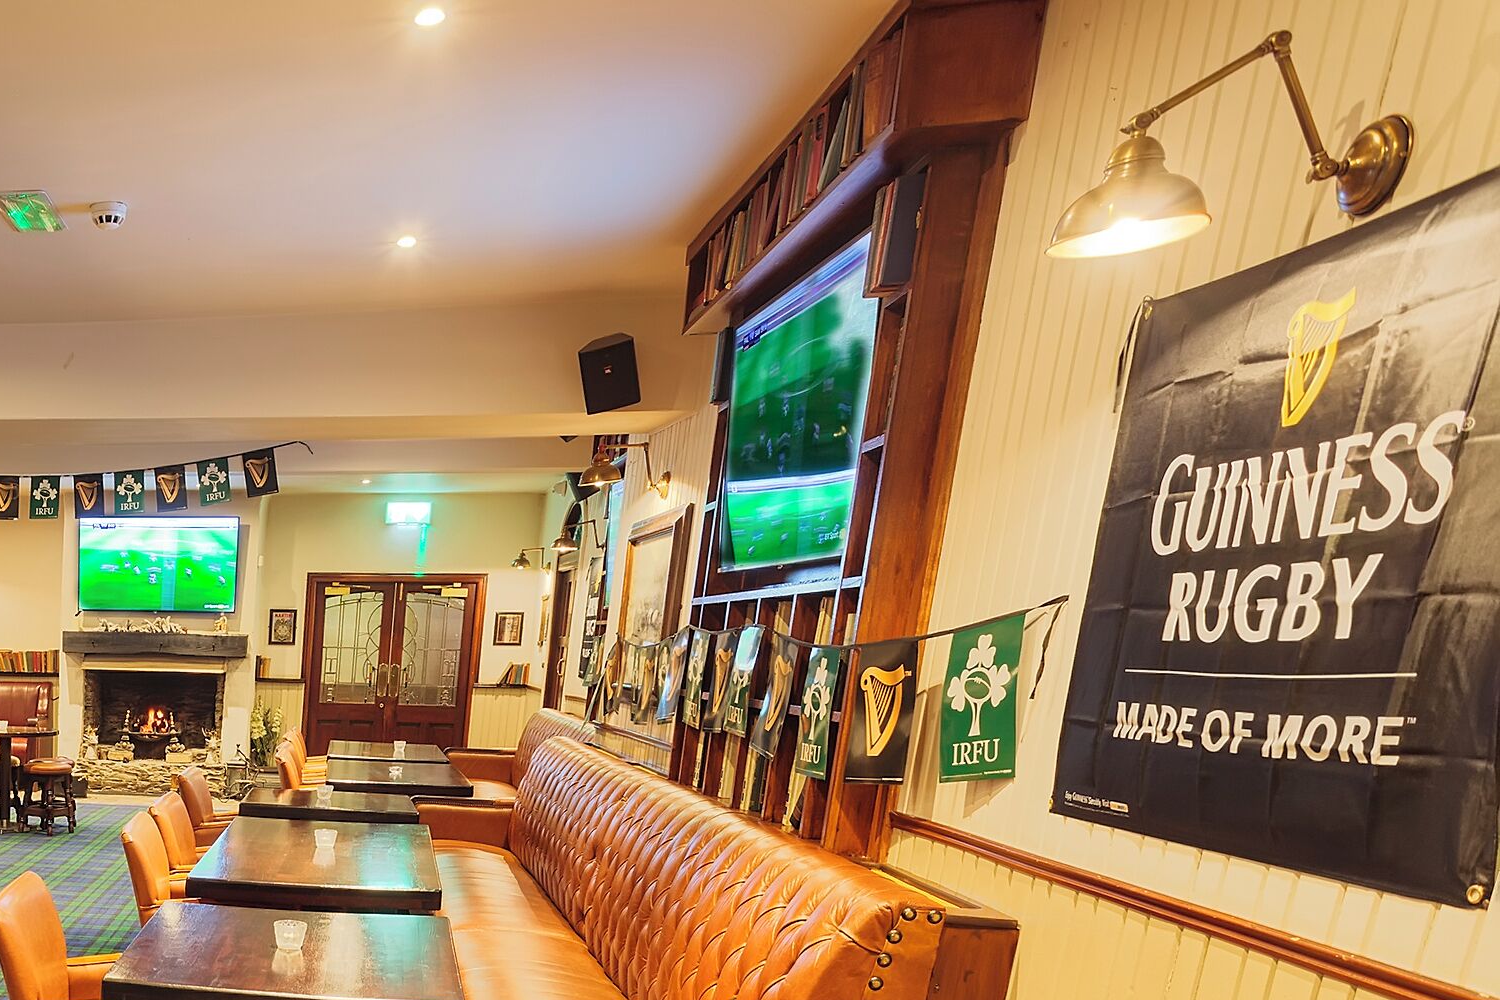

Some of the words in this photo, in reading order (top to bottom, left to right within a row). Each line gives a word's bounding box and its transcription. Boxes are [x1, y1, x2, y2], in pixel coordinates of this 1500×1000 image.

[120, 502, 140, 511] IRFU
[205, 491, 226, 502] IRFU
[35, 507, 54, 516] IRFU
[1162, 552, 1384, 643] RUGBY
[727, 704, 744, 725] IRFU
[1112, 701, 1198, 748] MADE
[1200, 709, 1255, 755] OF
[800, 742, 821, 764] IRFU
[952, 738, 1000, 766] IRFU
